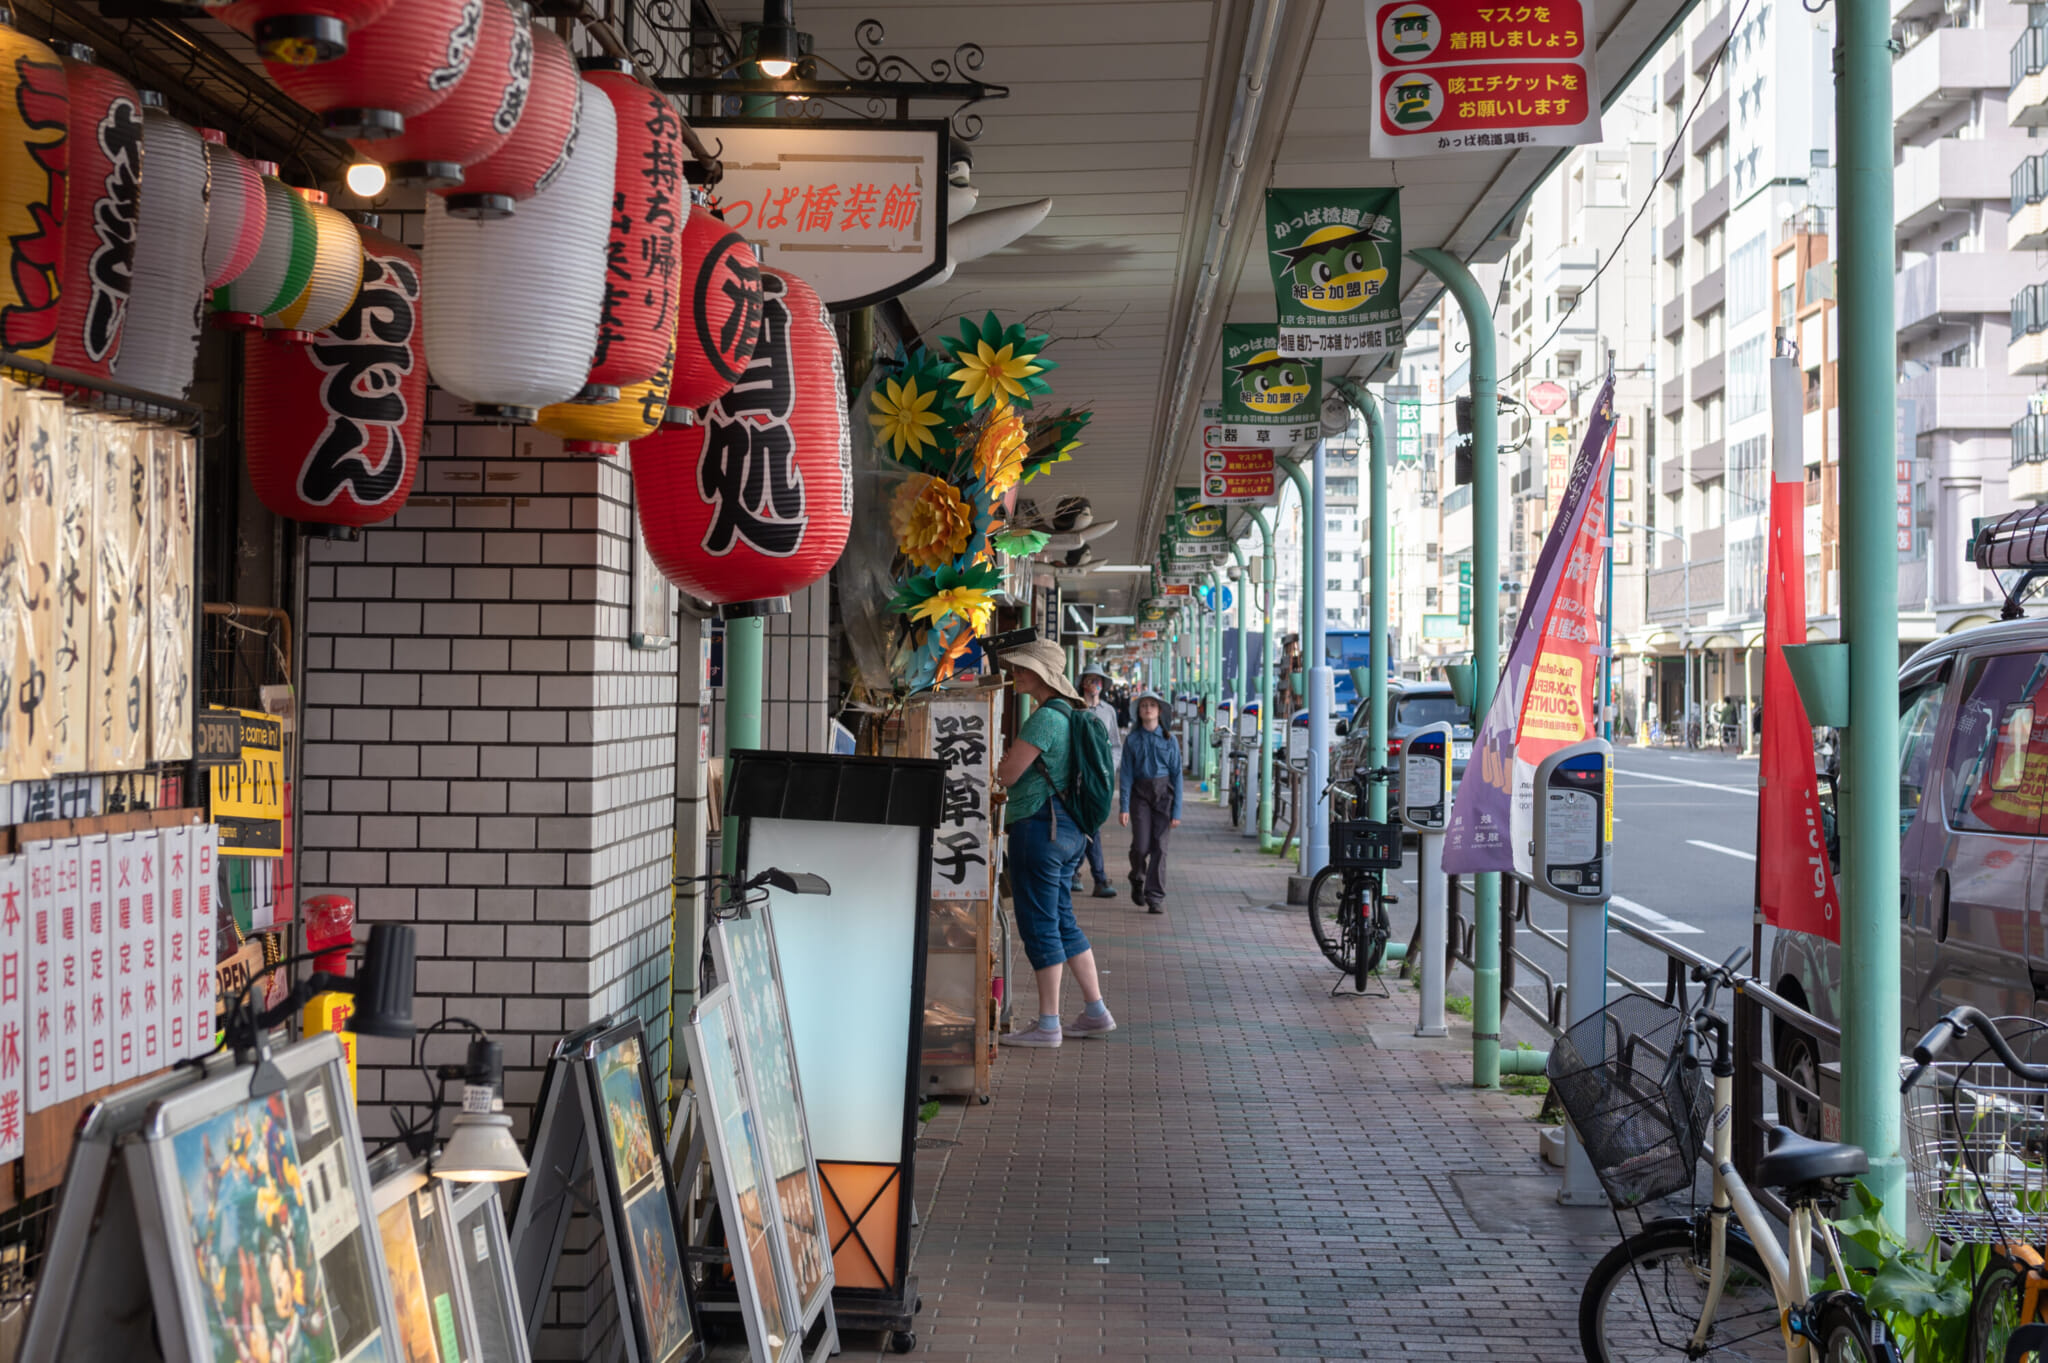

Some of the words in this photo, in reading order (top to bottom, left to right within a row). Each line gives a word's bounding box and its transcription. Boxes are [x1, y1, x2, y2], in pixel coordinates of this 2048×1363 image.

[1450, 30, 1578, 50] 着用しましょう
[1477, 7, 1550, 23] マスクを
[1448, 74, 1578, 95] 咳エチケットを
[1458, 98, 1570, 119] お願いします
[640, 93, 679, 331] お持ち帰り
[704, 183, 921, 233] っぱ橋装飾
[1292, 280, 1380, 300] 組合加盟店
[1240, 391, 1305, 405] 組合加盟店
[197, 723, 234, 753] OPEN
[246, 727, 267, 743] come
[933, 715, 986, 885] 器草子
[90, 859, 104, 1073] 月曜定休日
[118, 855, 132, 1066] 火曜定休日
[140, 851, 157, 1058] 水曜定休日
[171, 850, 183, 1049] 木曜定休日
[196, 845, 210, 1042] 日曜定休日
[0, 881, 20, 1149] 本日休業
